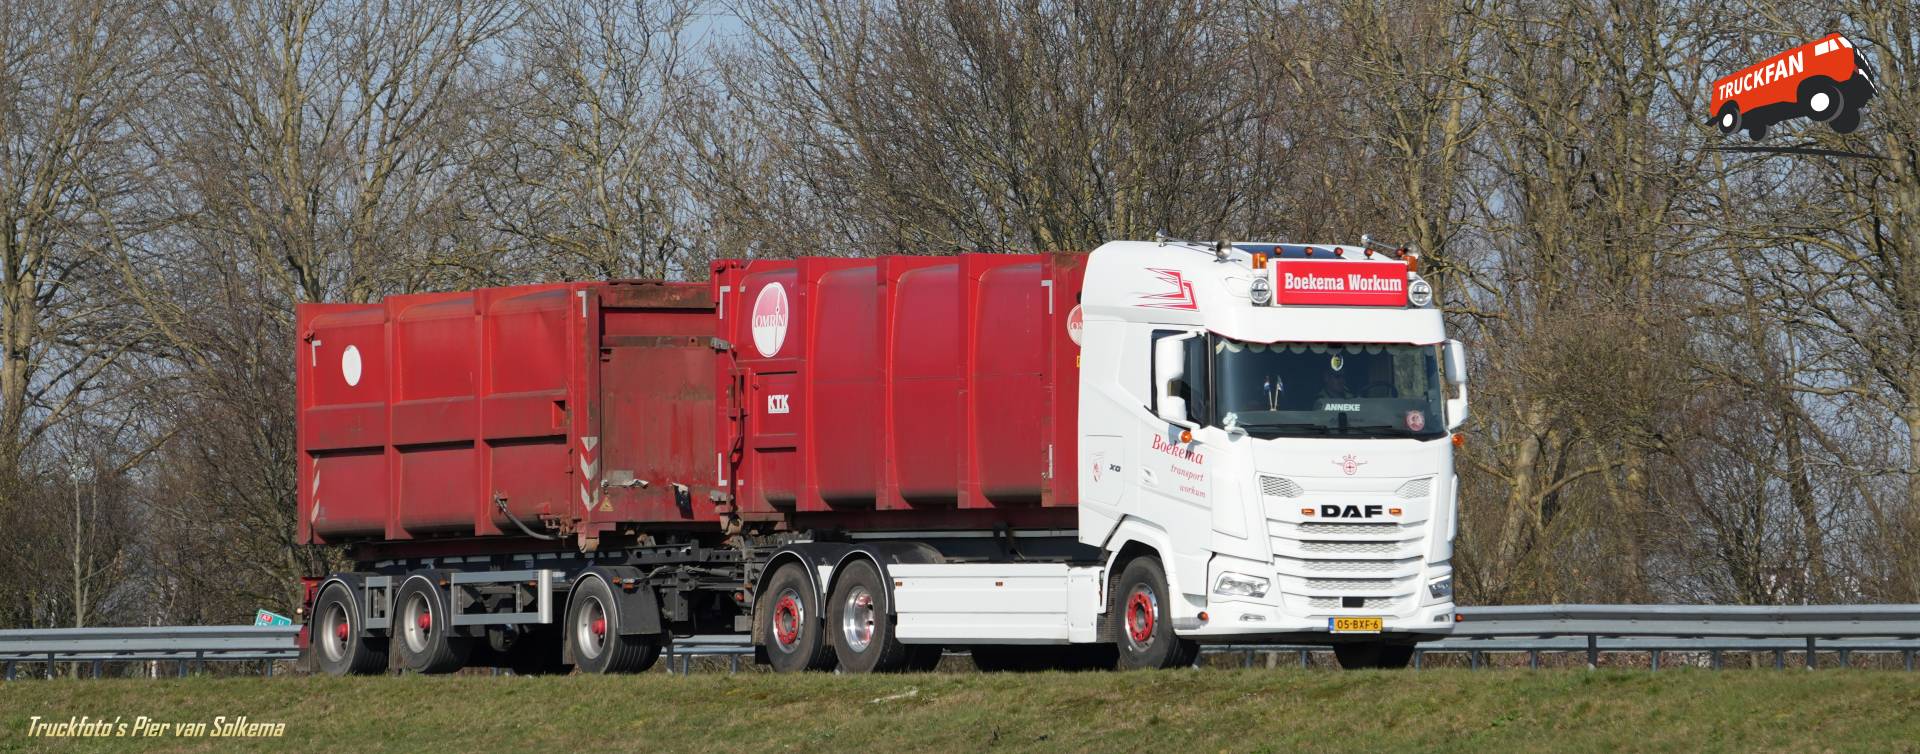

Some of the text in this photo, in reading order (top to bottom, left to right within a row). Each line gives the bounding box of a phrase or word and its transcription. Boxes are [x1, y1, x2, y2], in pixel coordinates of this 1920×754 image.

[1285, 273, 1402, 291] Boekema Workum
[768, 394, 789, 414] KTK
[1324, 403, 1361, 412] ANNEKE
[1152, 434, 1204, 465] Boekema
[1170, 464, 1204, 481] transport
[1321, 505, 1383, 518] DAF
[1337, 619, 1379, 629] 05-BXF-6
